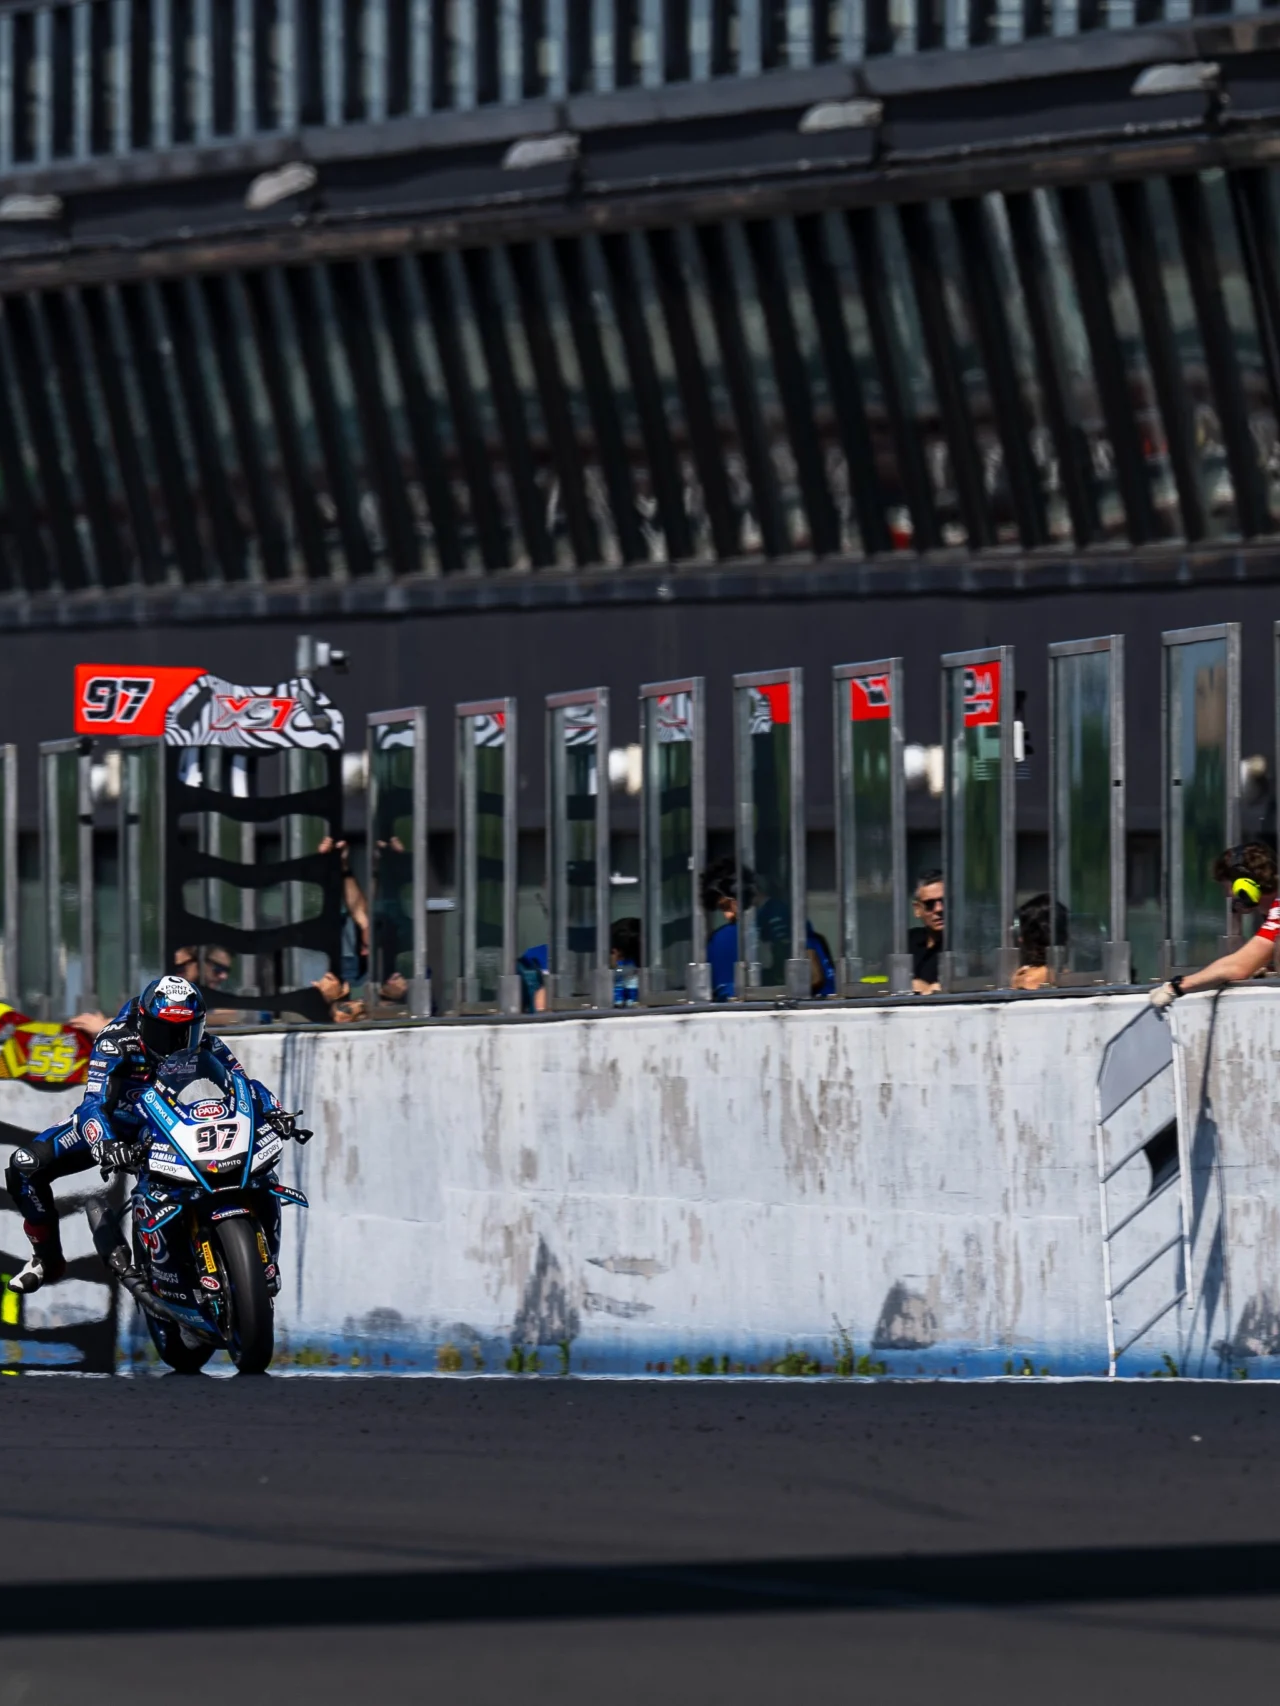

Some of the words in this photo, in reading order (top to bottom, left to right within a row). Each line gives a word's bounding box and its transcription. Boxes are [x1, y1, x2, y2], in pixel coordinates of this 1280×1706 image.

[82, 676, 155, 724] 97
[159, 1008, 193, 1016] LS2
[27, 1044, 75, 1077] 55
[197, 1103, 222, 1116] PATA
[195, 1122, 241, 1154] 97
[255, 1131, 278, 1148] YAMAHA
[151, 1151, 177, 1163] YAMAHA
[257, 1143, 280, 1161] Corpay
[150, 1161, 179, 1174] Corpay
[218, 1159, 242, 1168] AMPITO
[155, 1205, 176, 1220] JUTA
